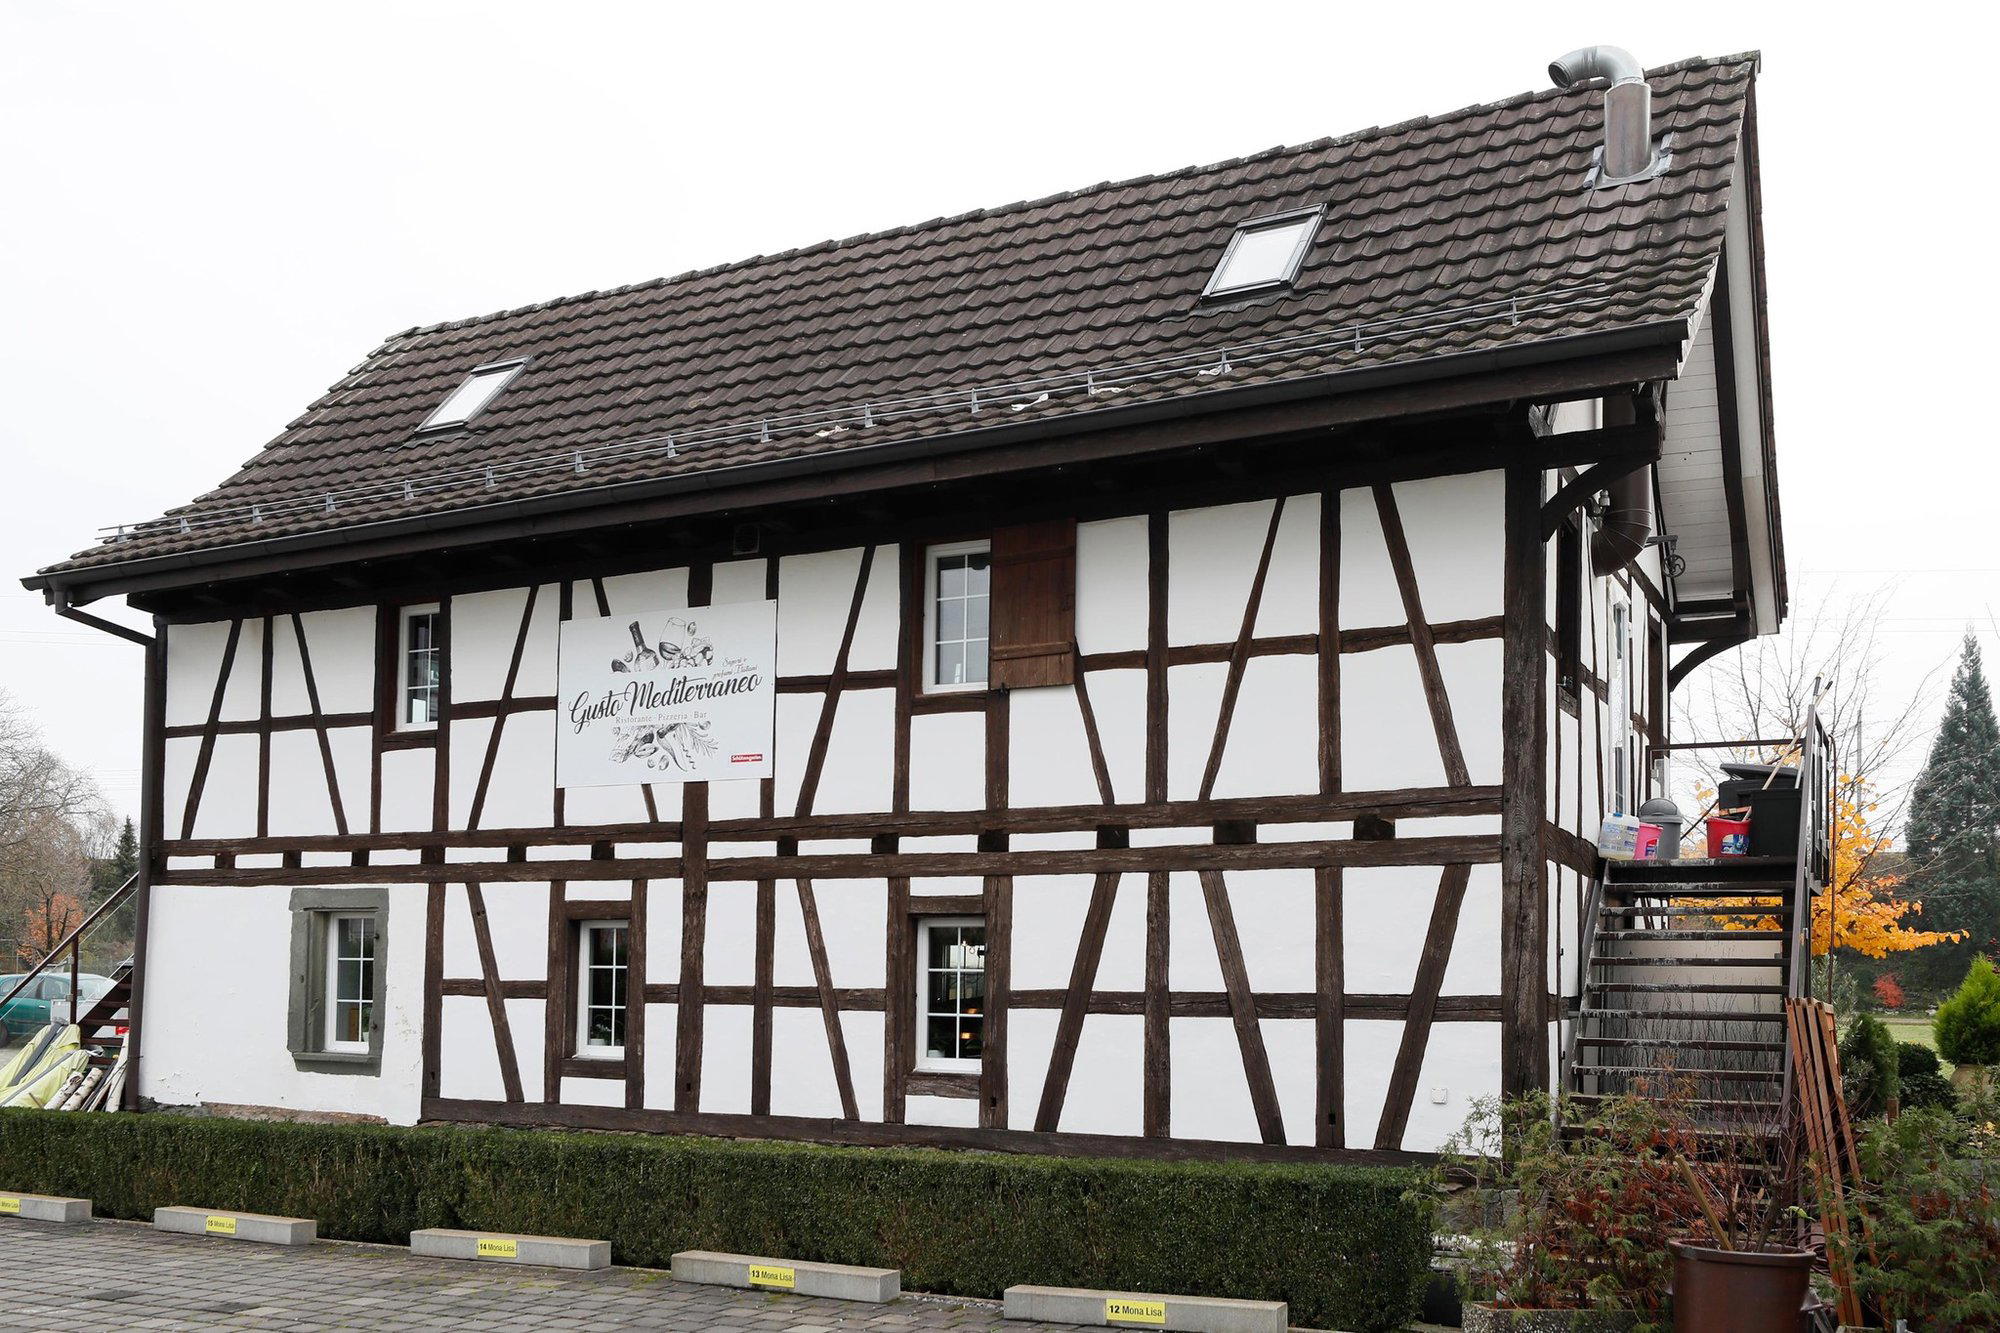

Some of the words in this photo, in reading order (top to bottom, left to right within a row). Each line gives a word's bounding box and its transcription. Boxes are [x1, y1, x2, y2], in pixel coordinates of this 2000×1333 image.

[568, 690, 630, 734] Gusto
[624, 673, 762, 716] Mediterraneo
[615, 716, 652, 724] Ristorante
[658, 713, 688, 721] Pizzeria
[693, 711, 707, 719] Bar
[488, 1244, 503, 1252] Mona
[504, 1244, 514, 1252] Lisa
[752, 1270, 760, 1278] 13
[761, 1270, 778, 1280] Mona
[779, 1272, 792, 1281] Lisa
[1109, 1305, 1120, 1314] 12
[1122, 1306, 1144, 1316] Mona
[1146, 1307, 1163, 1317] Lisa
